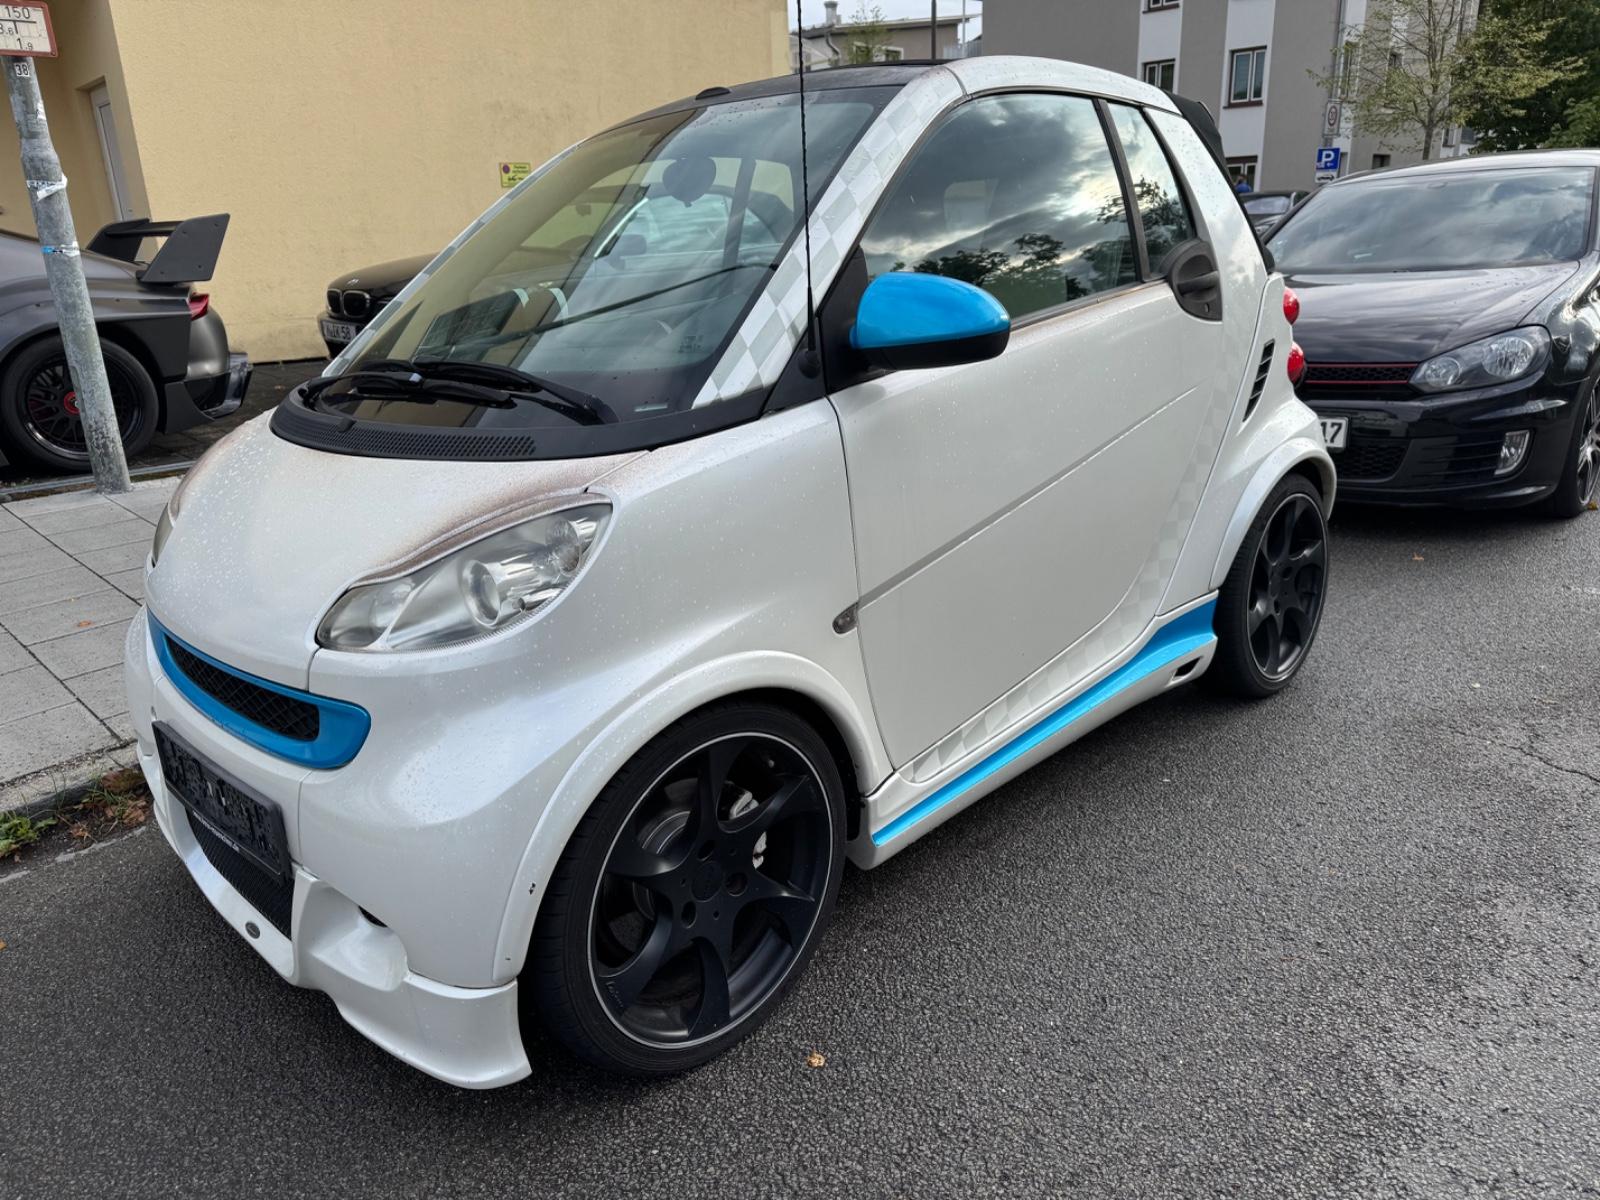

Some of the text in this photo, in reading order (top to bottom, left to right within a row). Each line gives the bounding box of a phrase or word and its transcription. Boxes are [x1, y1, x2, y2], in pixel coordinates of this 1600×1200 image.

[5, 6, 31, 19] 150
[15, 63, 29, 76] 38
[1322, 150, 1335, 168] P
[1320, 421, 1343, 443] 17
